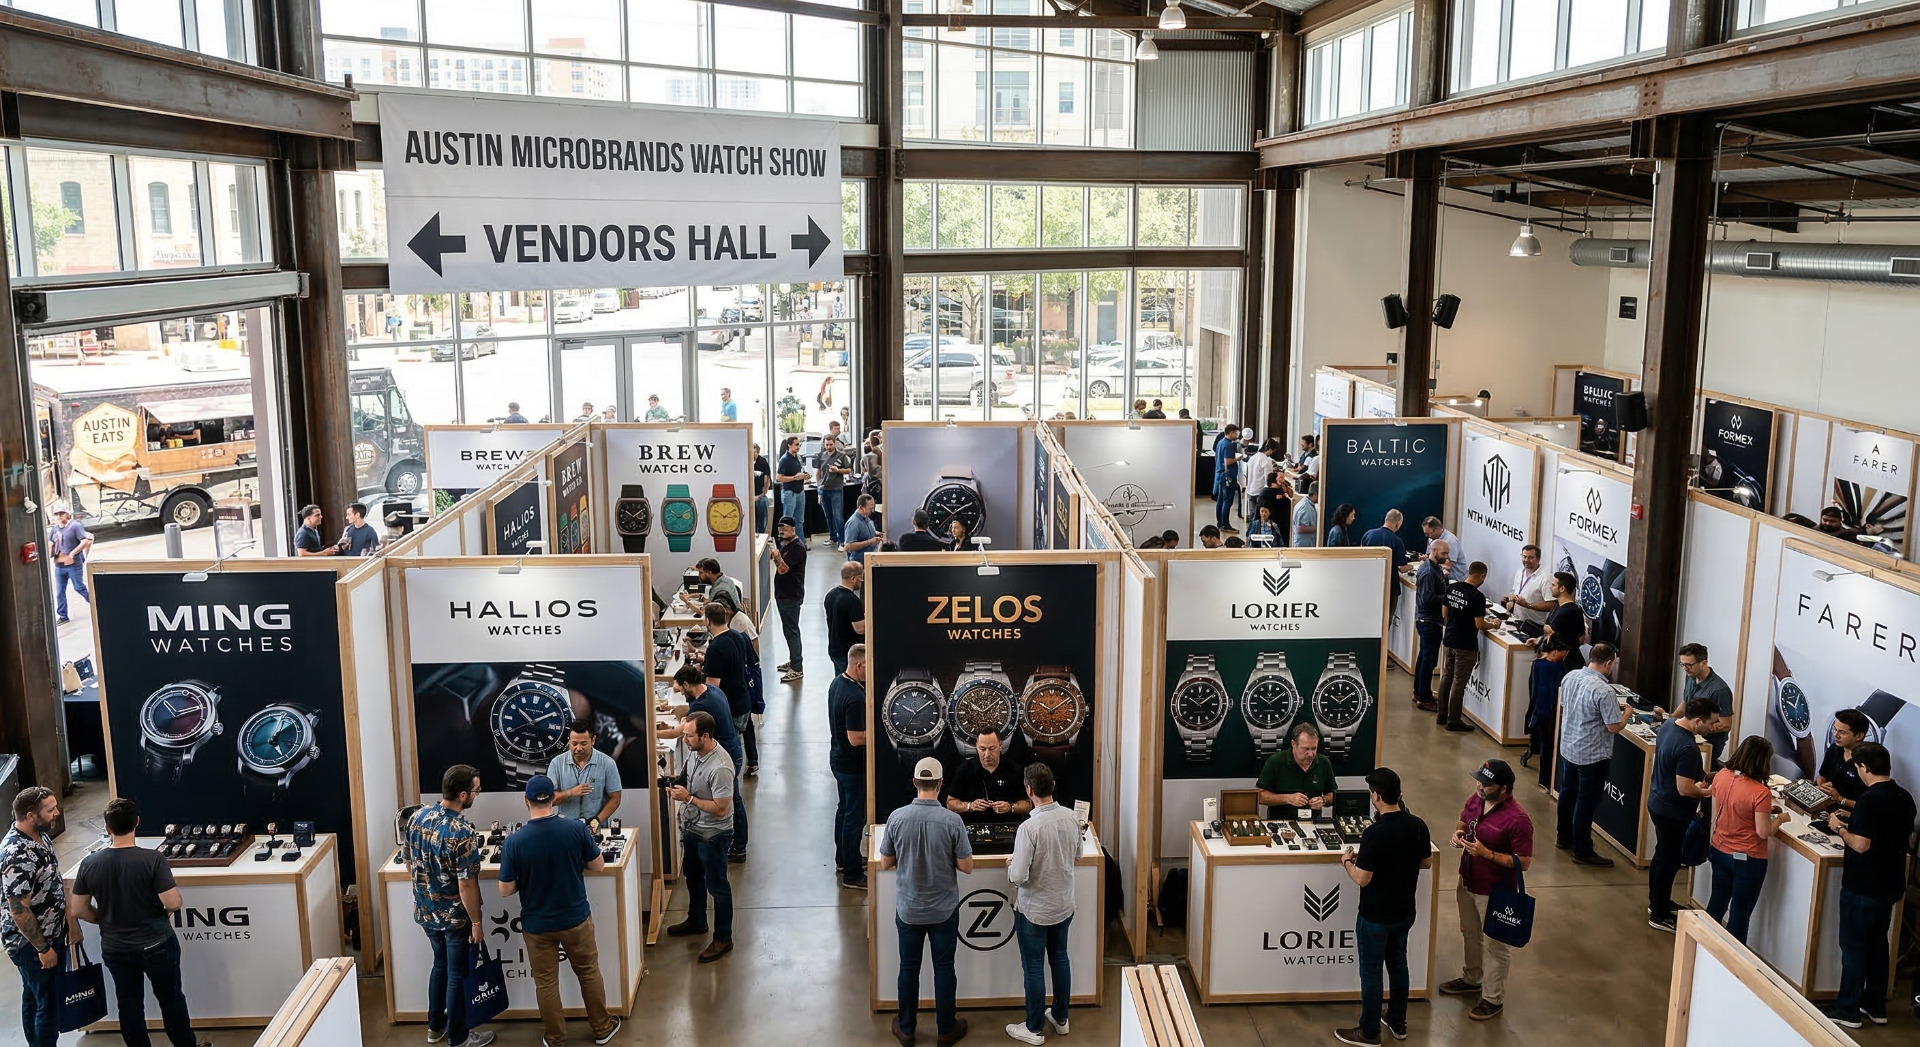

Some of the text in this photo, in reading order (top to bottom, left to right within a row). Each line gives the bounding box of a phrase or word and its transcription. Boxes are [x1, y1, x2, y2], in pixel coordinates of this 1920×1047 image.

[405, 130, 827, 177] AUSTIN MICROBRANDS WATCH SHOW
[483, 224, 777, 263] VENDORS HALL
[83, 416, 131, 432] AUSTIN
[92, 431, 124, 444] EATS
[1346, 438, 1426, 454] BALTIC
[1718, 429, 1753, 446] FORMEX
[639, 444, 716, 460] BREW
[639, 464, 717, 473] WATCH CO.
[1360, 458, 1412, 466] WATCHES
[1853, 454, 1898, 475] FARER
[561, 457, 583, 486] BREW
[503, 505, 535, 541] HALIOS
[1467, 508, 1523, 542] NTH WATCHES
[1569, 512, 1618, 544] FORMEX
[450, 599, 598, 618] HALIOS
[927, 594, 1043, 624] ZELOS
[1231, 603, 1320, 618] LORIER
[147, 603, 292, 632] MING
[488, 625, 562, 636] WATCHES
[947, 628, 1021, 640] WATCHES
[1250, 623, 1301, 631] WATCHES
[1798, 593, 1917, 663] FARER
[151, 637, 293, 653] WATCHES
[173, 906, 250, 928] ING
[183, 931, 251, 941] WATCHES
[1263, 930, 1355, 950] LORIE
[1283, 955, 1355, 965] WATCHES
